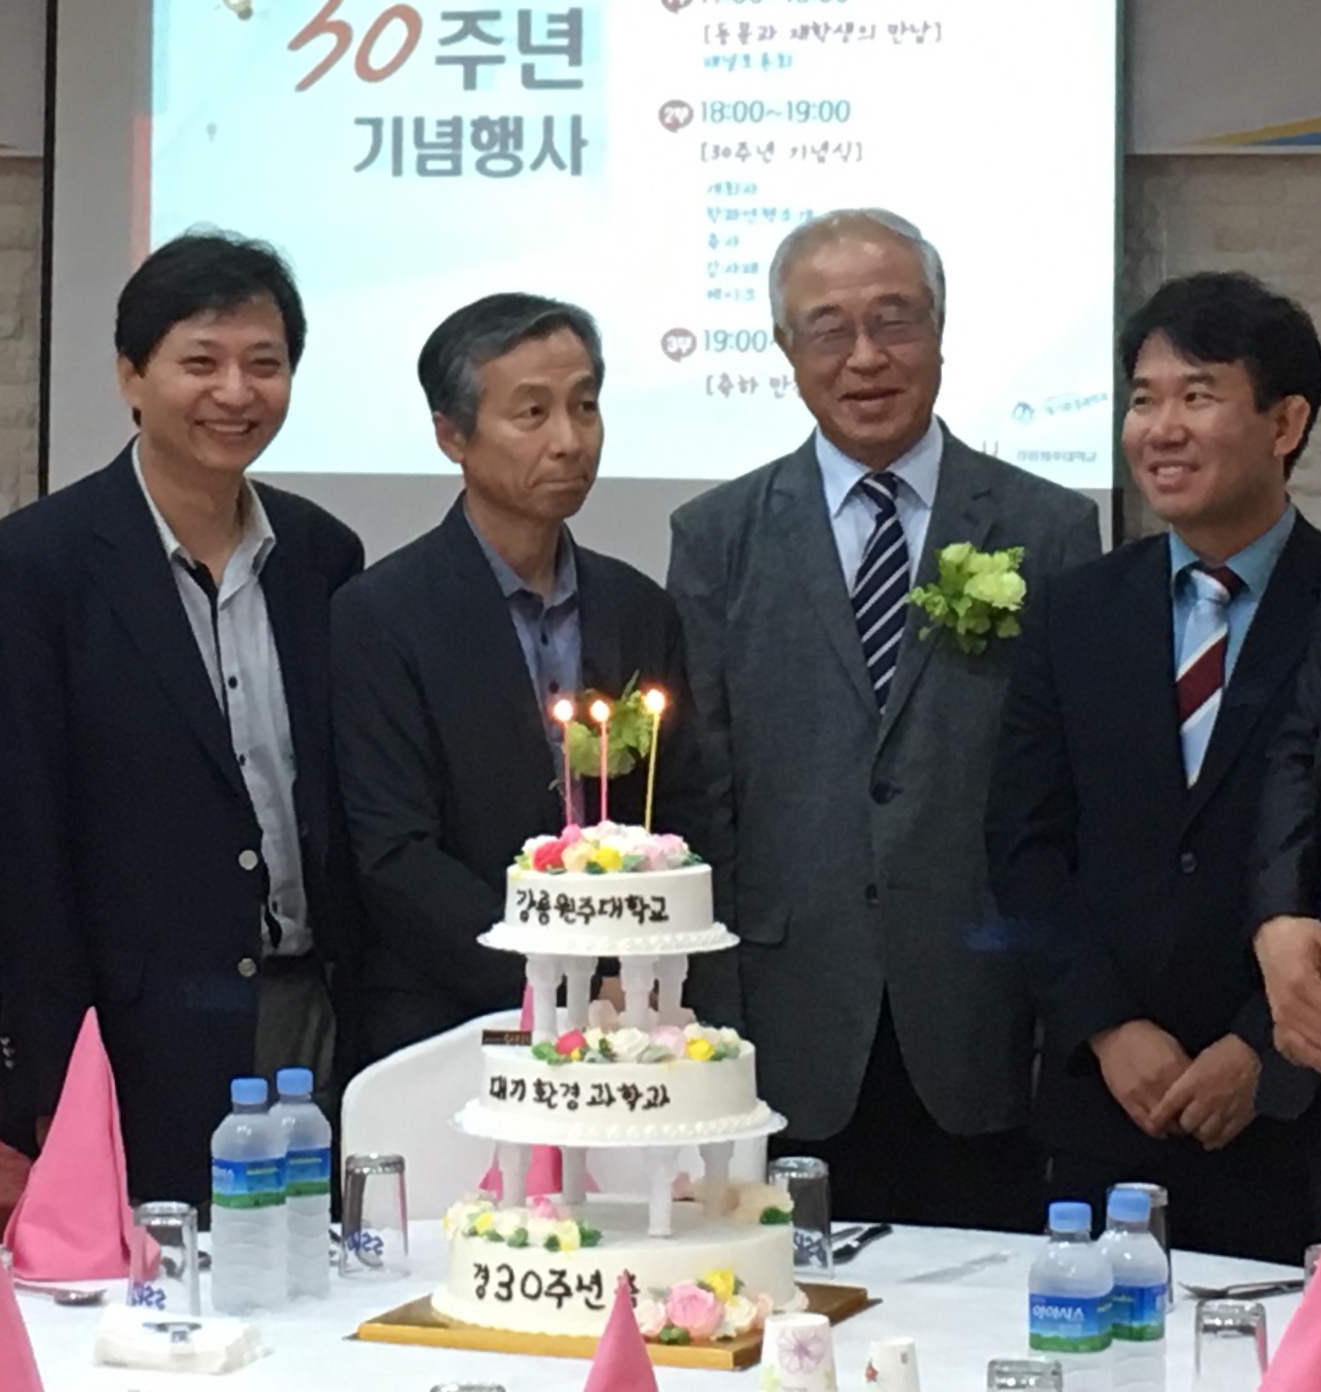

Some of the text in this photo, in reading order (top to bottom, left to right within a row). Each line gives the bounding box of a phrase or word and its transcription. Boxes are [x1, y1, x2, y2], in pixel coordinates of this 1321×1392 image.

[701, 99, 851, 124] 18:00~19:00
[353, 114, 589, 179] 기념행사
[516, 888, 669, 925] 강릉원주대학교
